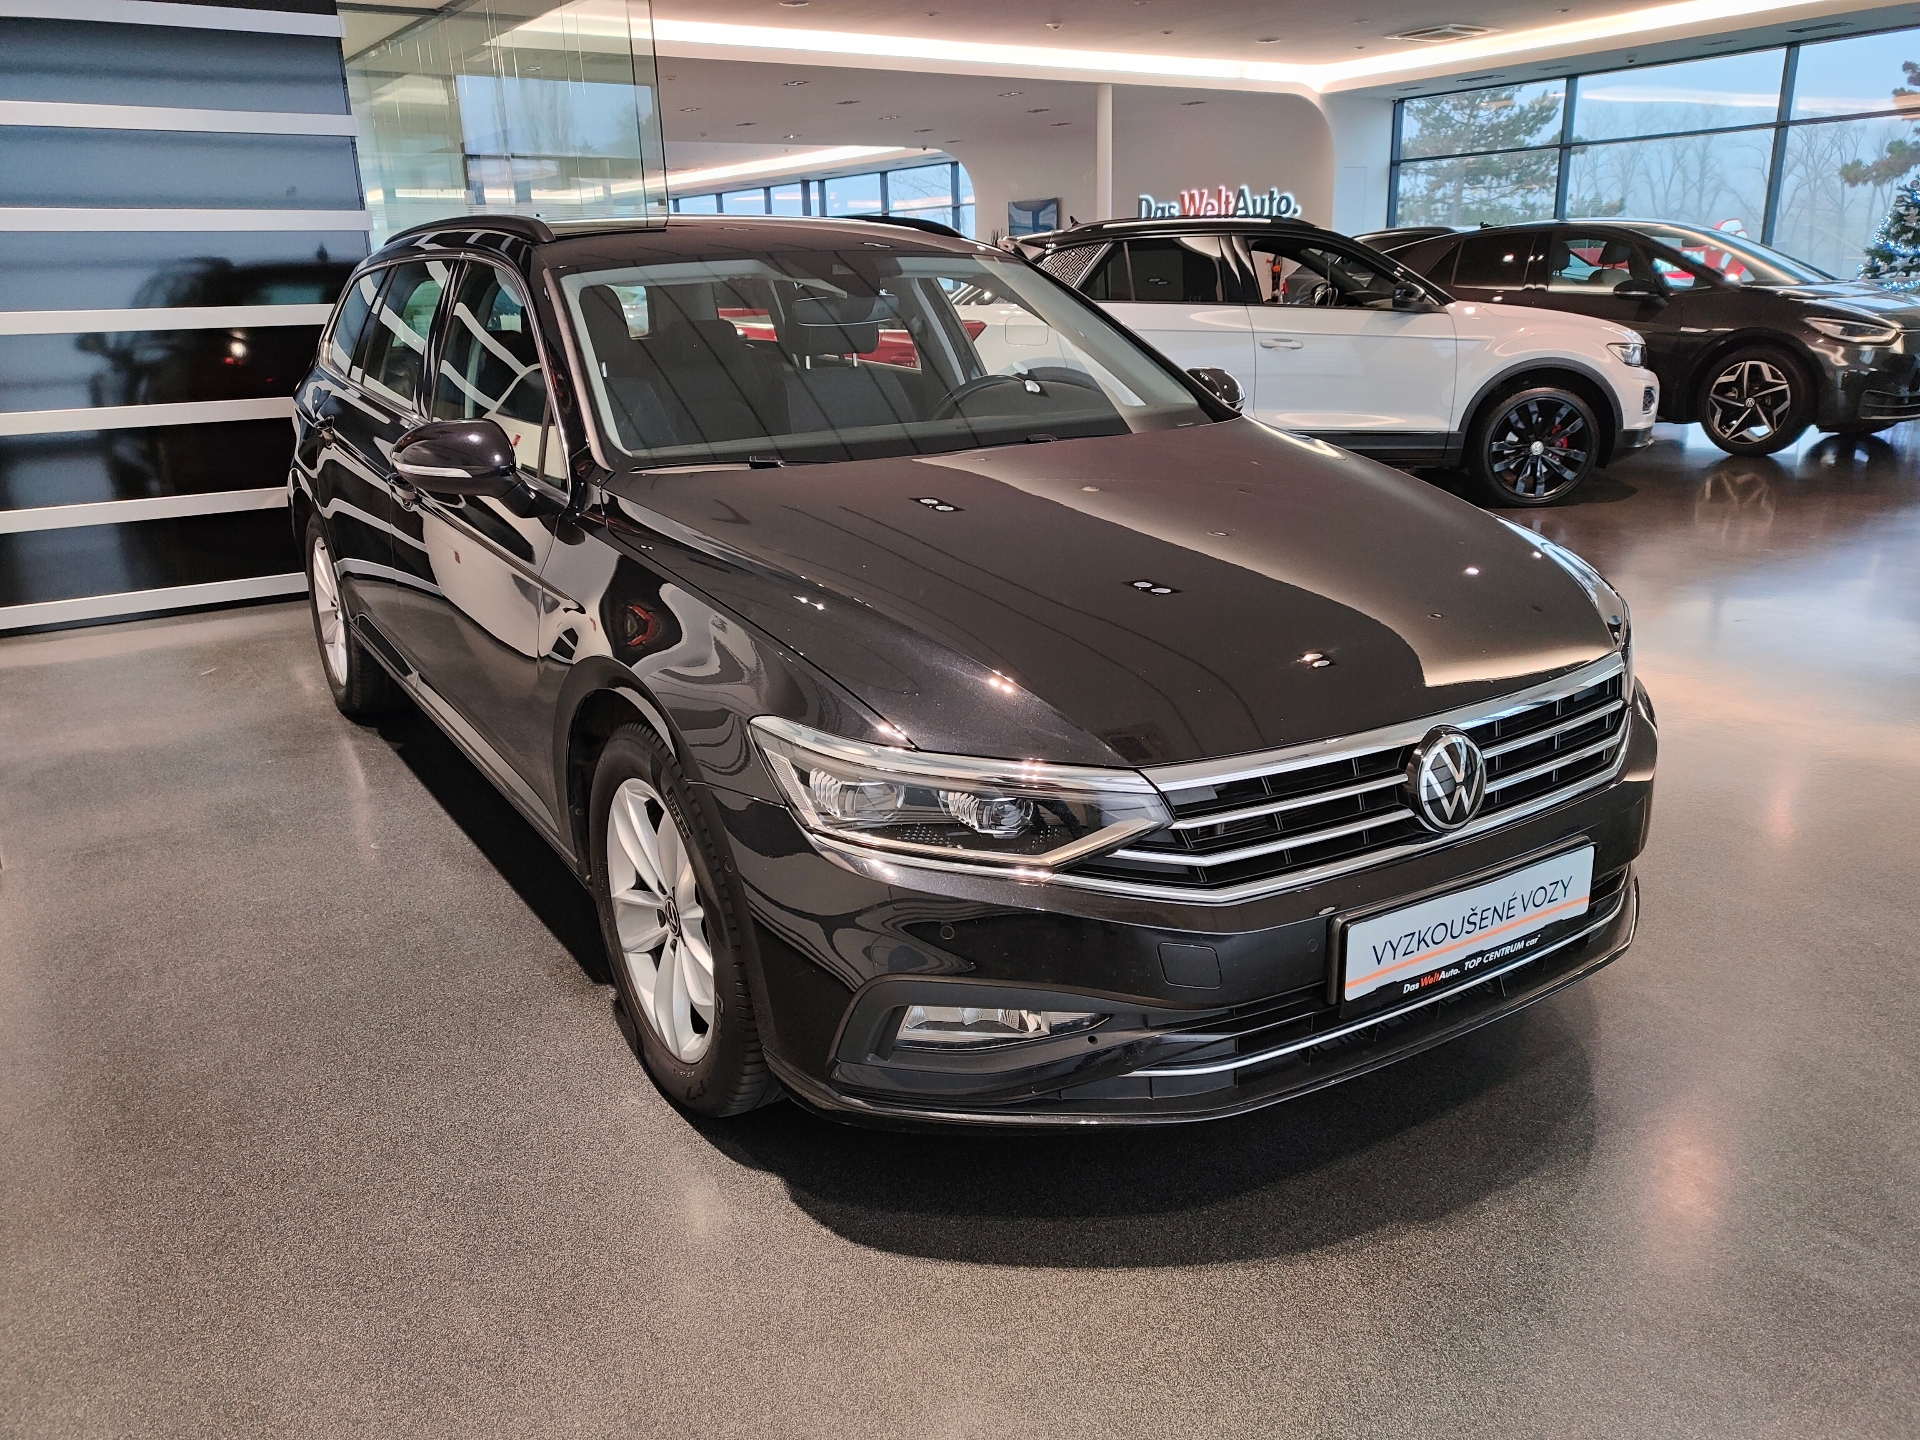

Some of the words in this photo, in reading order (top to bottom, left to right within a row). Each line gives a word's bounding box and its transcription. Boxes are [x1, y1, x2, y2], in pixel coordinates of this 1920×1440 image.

[1138, 194, 1179, 218] Das
[1372, 892, 1518, 966] VYZKOUŠENÉ
[1521, 876, 1573, 913] VOZY
[1403, 982, 1420, 994] Das
[1464, 958, 1482, 971] TOP
[1483, 940, 1525, 964] CENTRUM
